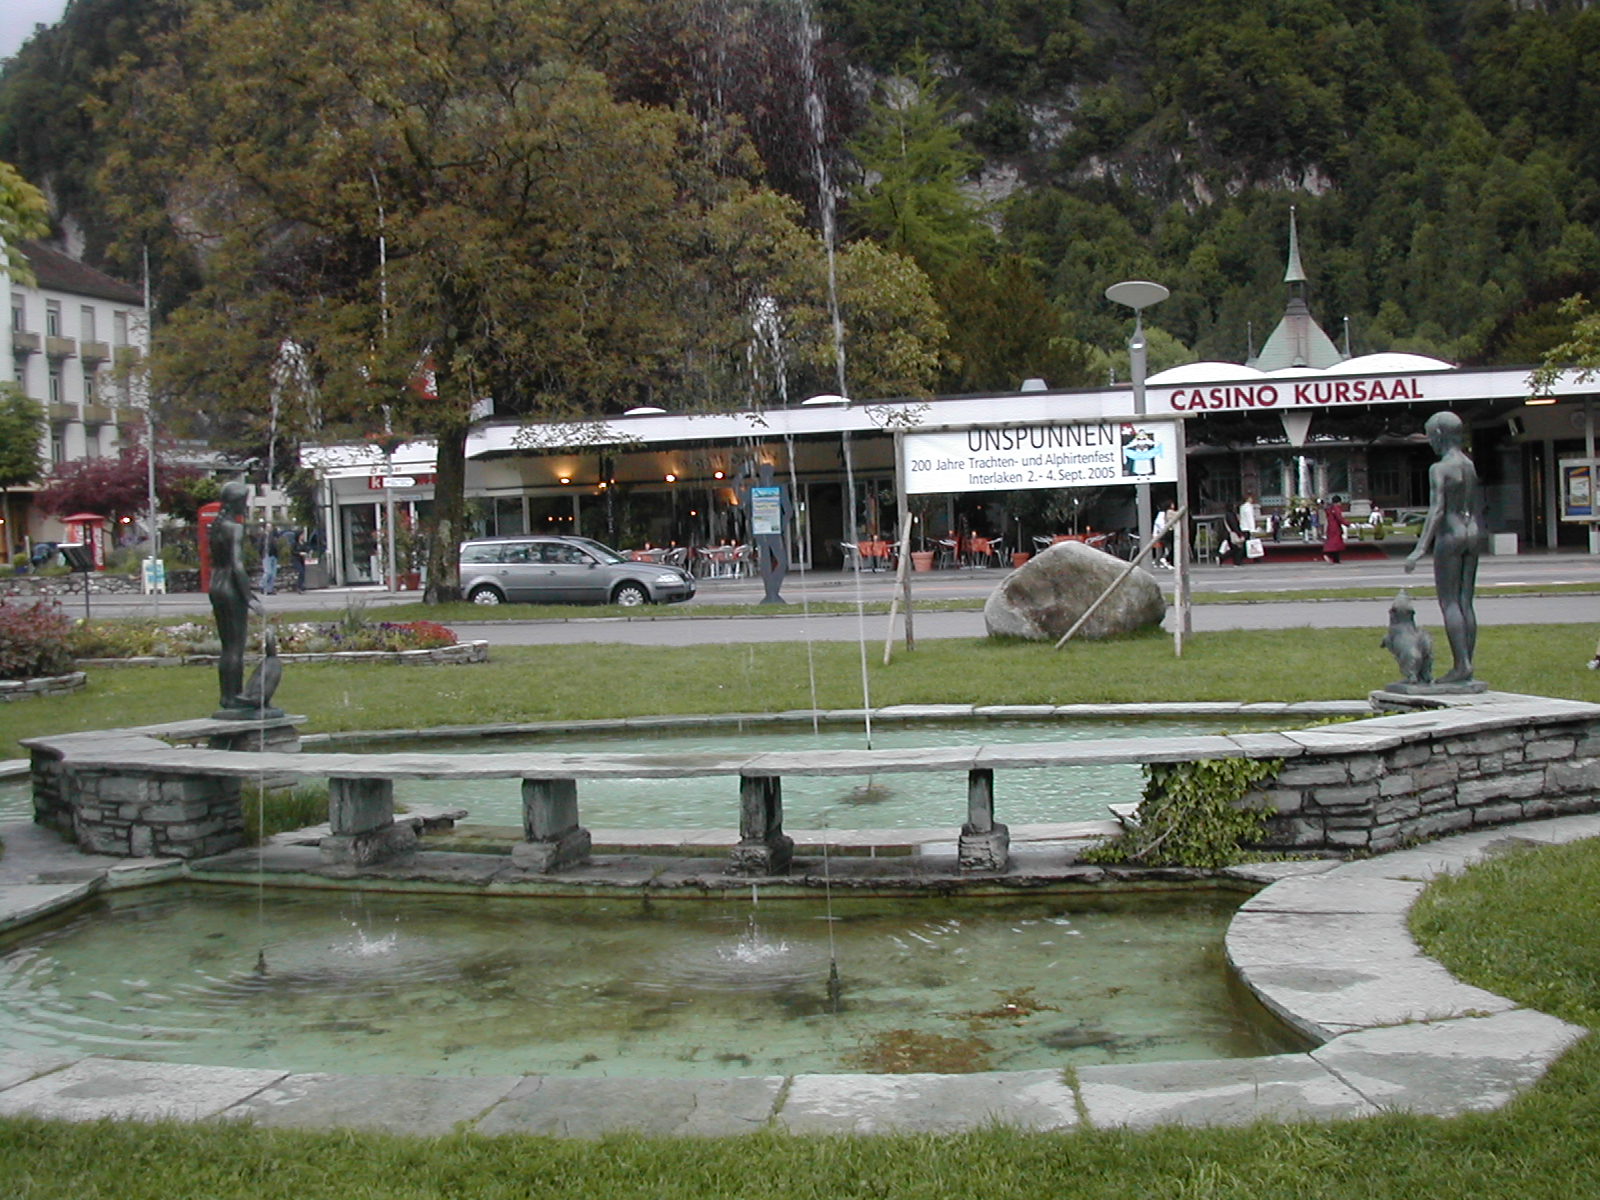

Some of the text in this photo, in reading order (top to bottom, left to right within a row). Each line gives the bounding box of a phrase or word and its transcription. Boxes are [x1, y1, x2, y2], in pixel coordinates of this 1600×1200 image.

[1170, 378, 1424, 411] CASINO KURSAAL
[967, 424, 1114, 452] UNSPUNNEN
[911, 450, 1115, 472] 200 Jahre Trachten- und Alphirtenfest
[969, 471, 1023, 484] Interlaken
[1046, 470, 1057, 481] 4.
[1058, 469, 1086, 483] Sept.
[1088, 466, 1116, 479] 2005
